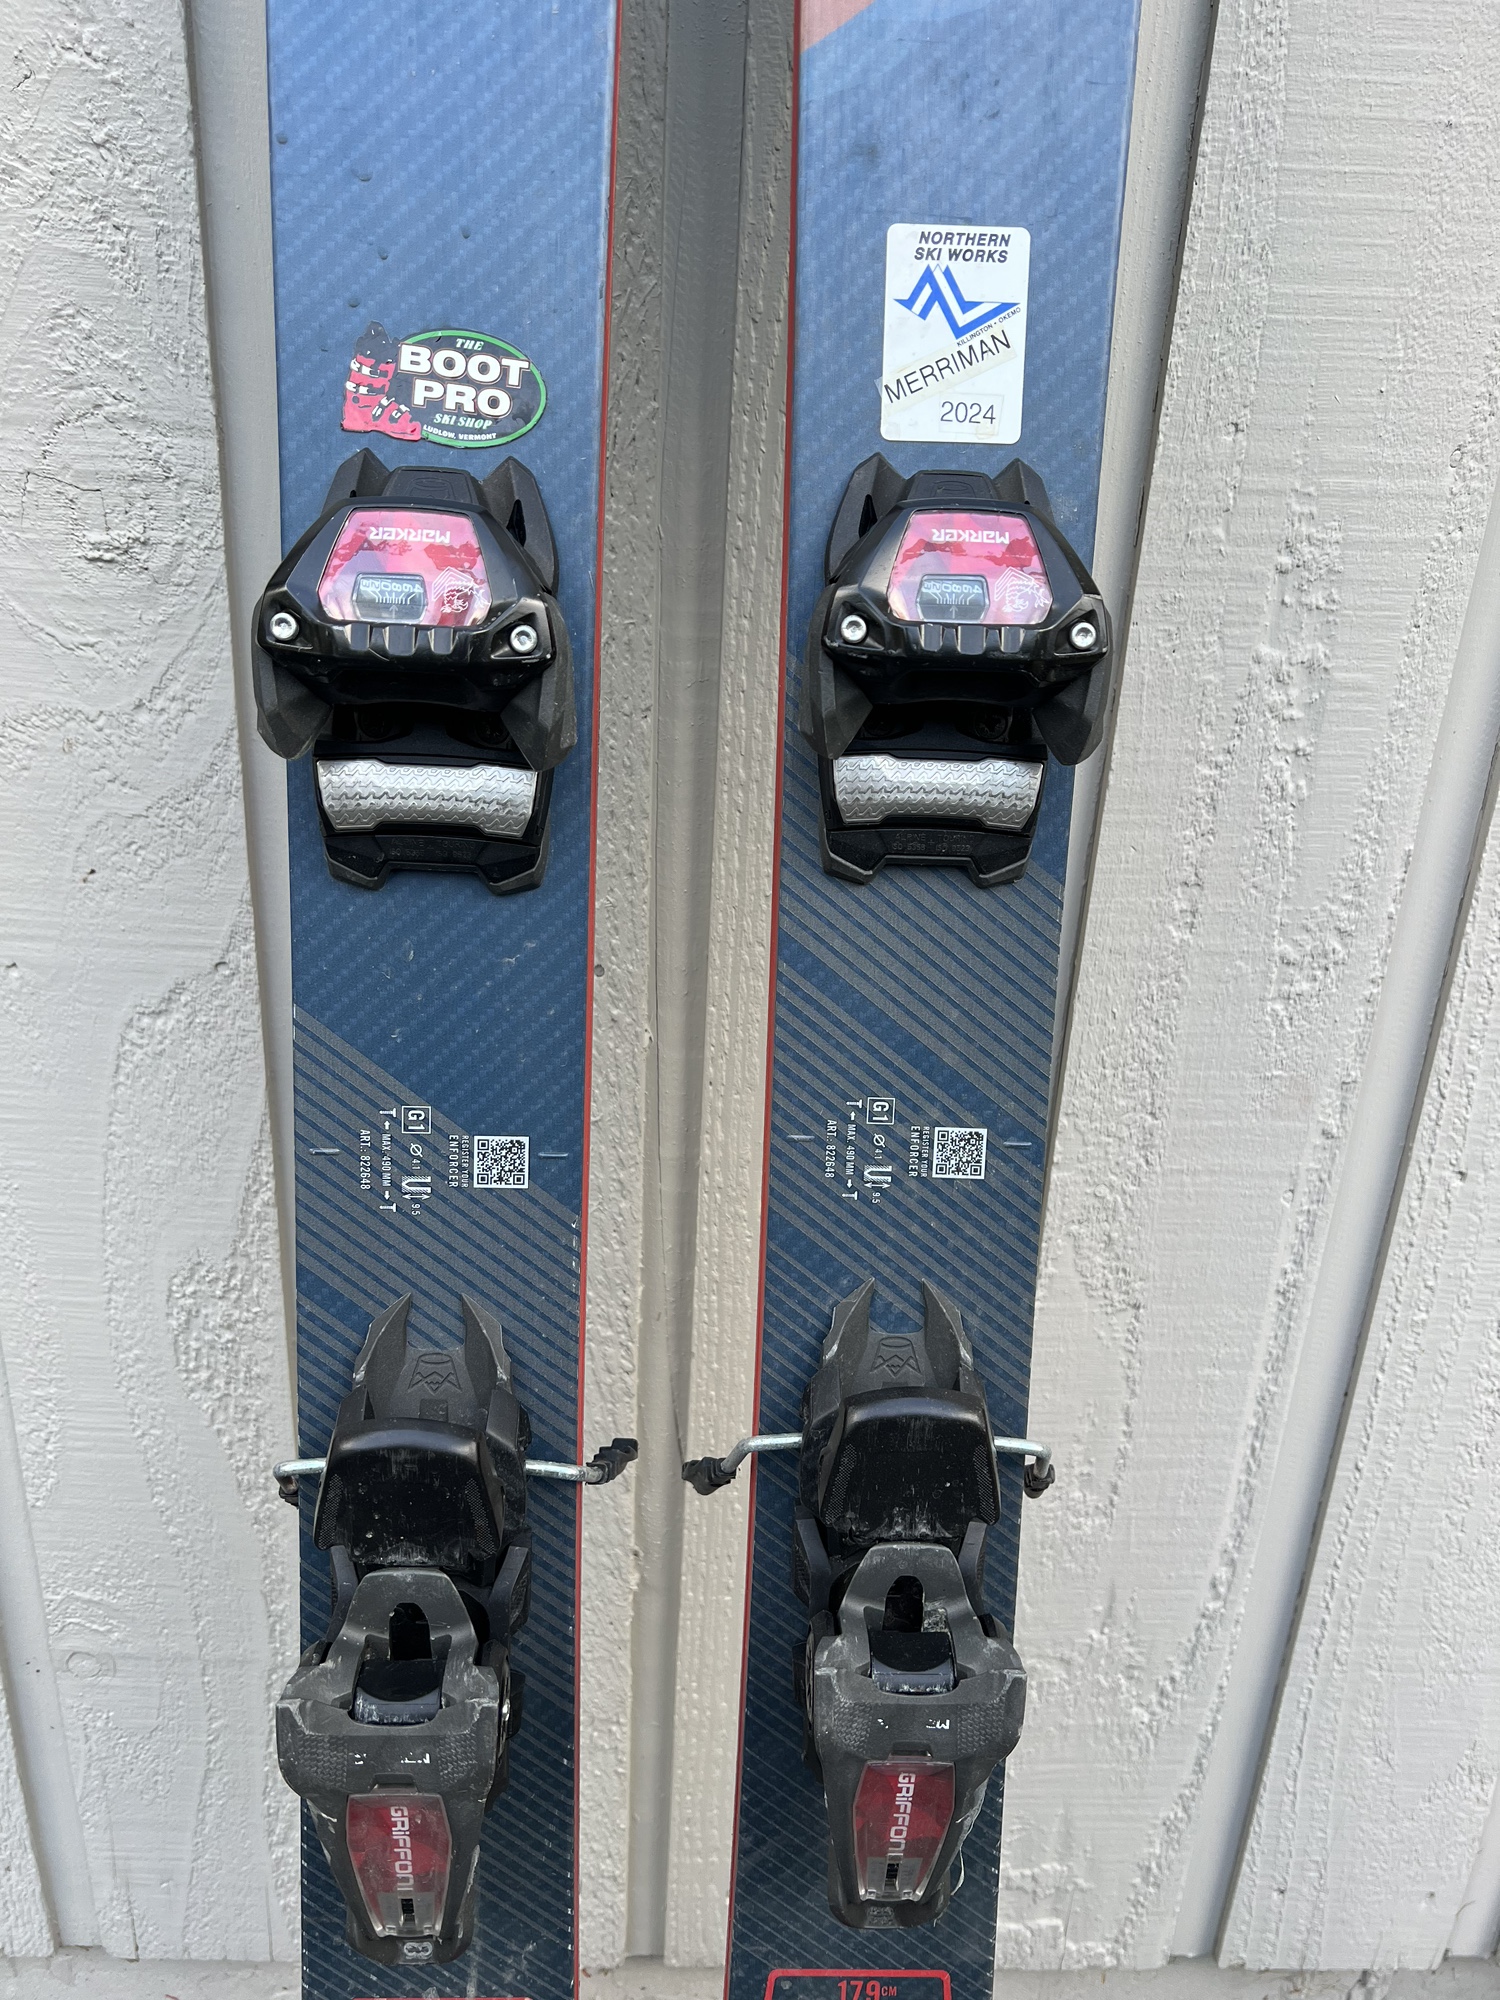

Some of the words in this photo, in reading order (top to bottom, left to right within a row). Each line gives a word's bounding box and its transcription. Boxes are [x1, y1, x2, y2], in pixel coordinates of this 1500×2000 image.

[919, 231, 1011, 247] NORTHERN
[914, 247, 943, 261] SKI
[948, 248, 1009, 263] WORKS
[956, 322, 993, 347] KILLINGTON
[998, 306, 1021, 324] OKEMO
[455, 338, 485, 351] THE
[398, 344, 531, 387] BOOT
[884, 329, 1011, 403] MERRIMAN
[412, 378, 512, 417] PRO
[434, 413, 456, 426] SKI
[457, 416, 493, 430] SHOP
[940, 401, 996, 425] 2024
[423, 425, 456, 440] LUDLOW,
[458, 432, 497, 441] VERMONT
[407, 1110, 425, 1130] G1
[873, 1101, 889, 1122] G1
[461, 1135, 469, 1167] REGISTER
[908, 1126, 920, 1177] ENFORCER
[922, 1126, 930, 1158] REGISTER
[449, 1135, 458, 1187] ENFORCER
[825, 1144, 836, 1178] 822648
[846, 1145, 855, 1162] 490
[874, 1148, 883, 1160] 4.1
[360, 1155, 370, 1190] 822648
[382, 1156, 391, 1172] 490
[411, 1159, 421, 1170] 4.1
[845, 1162, 854, 1175] MM
[382, 1174, 391, 1187] MM
[461, 1168, 469, 1187] YOUR
[872, 1192, 880, 1204] 9.5
[411, 1204, 421, 1215] 9.5
